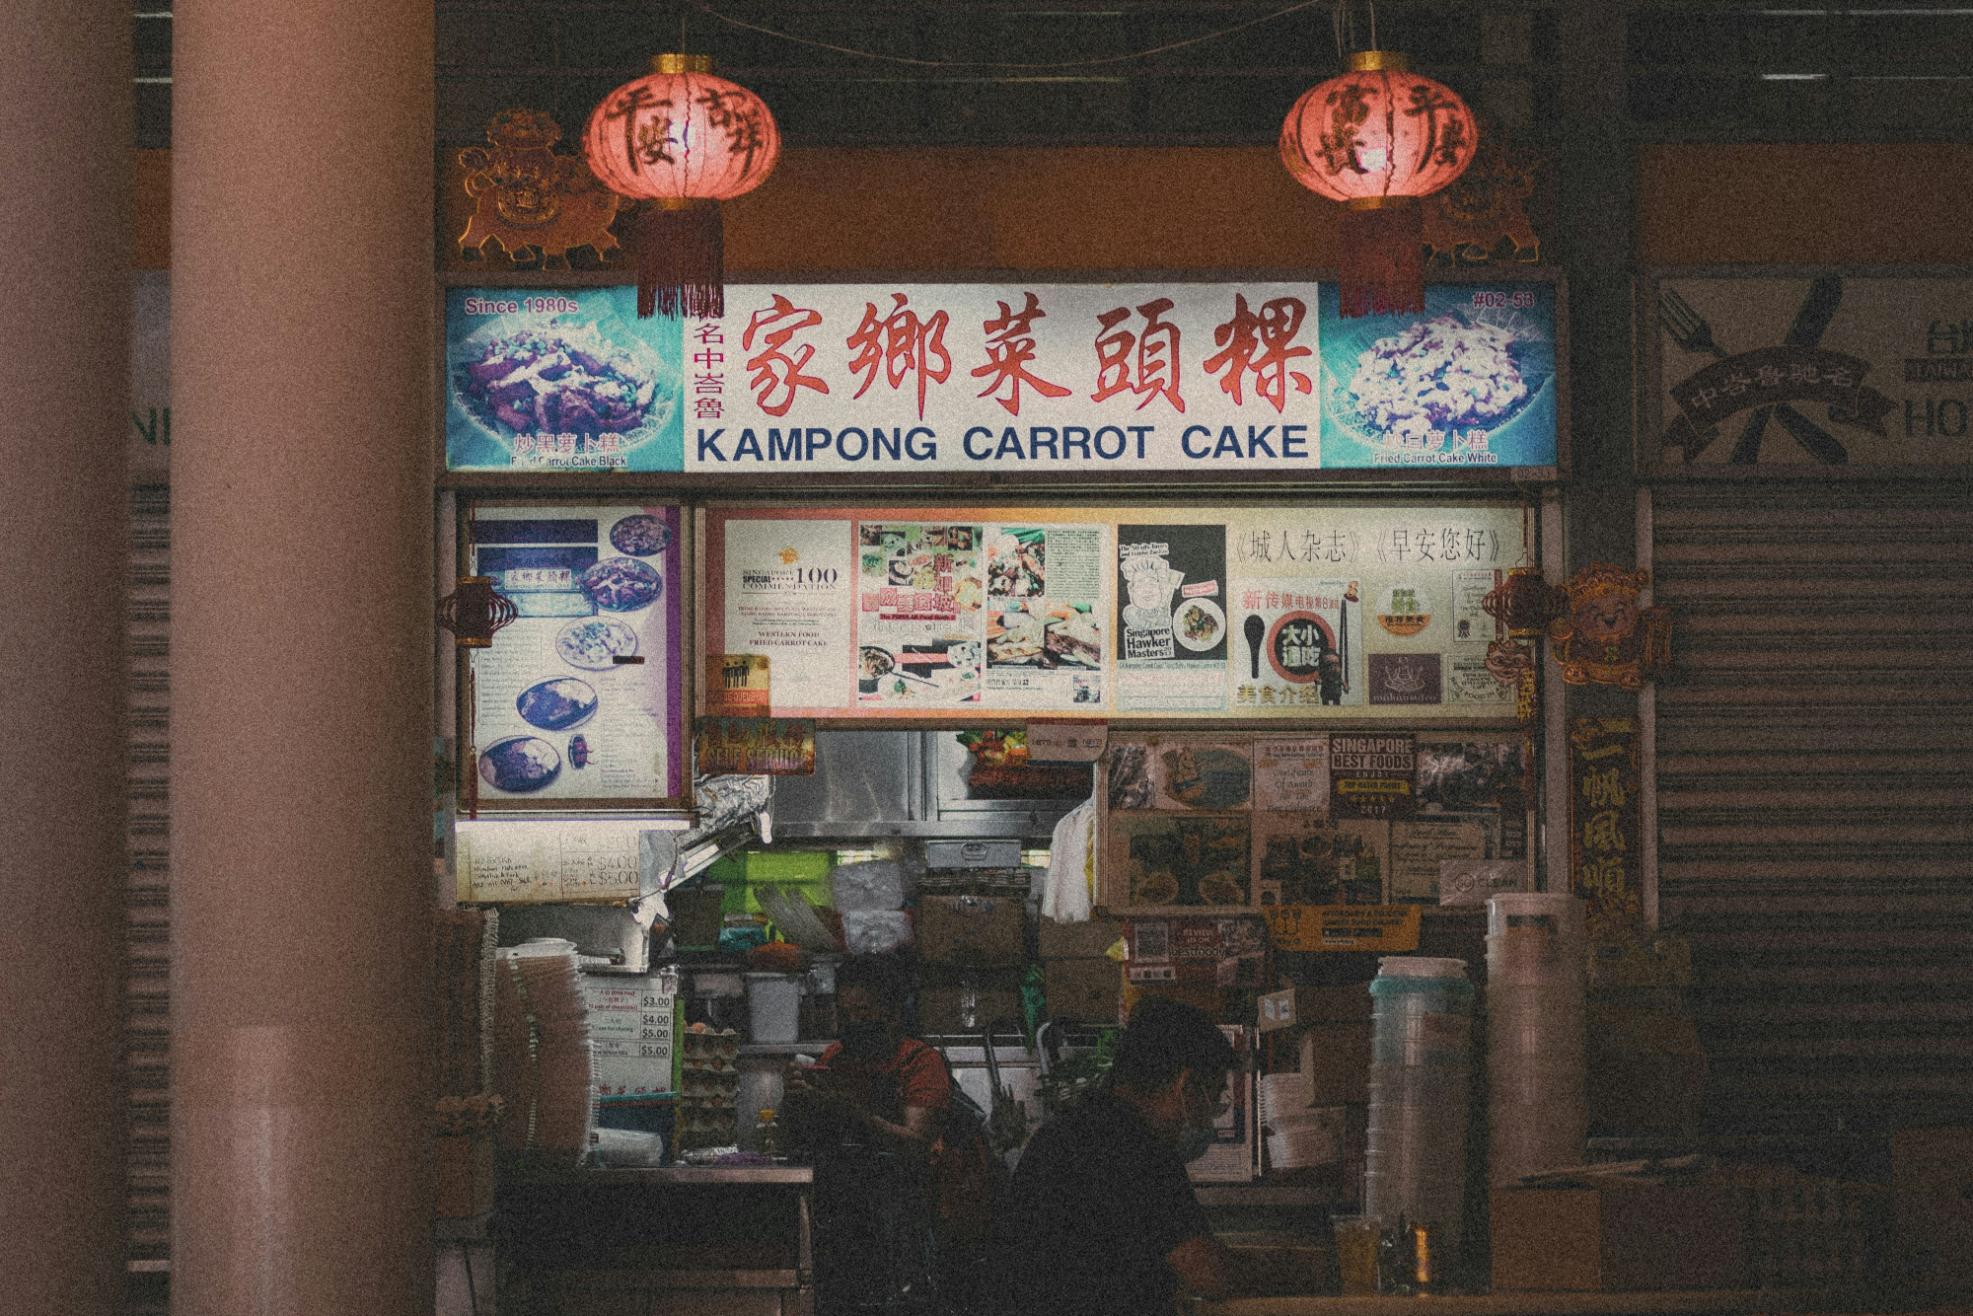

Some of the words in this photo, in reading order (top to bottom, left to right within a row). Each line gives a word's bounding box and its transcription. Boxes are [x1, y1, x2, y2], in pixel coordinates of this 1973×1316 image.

[466, 297, 518, 314] Since
[524, 297, 579, 313] 1980s
[698, 427, 938, 461] KAMPONG
[963, 426, 1154, 460] CARROT
[1181, 425, 1309, 458] CAKE
[571, 456, 598, 467] Cake
[600, 456, 627, 467] Black
[1374, 453, 1401, 464] Fried
[1403, 453, 1437, 464] Carrot
[1439, 453, 1465, 464] Cake
[1466, 453, 1498, 464] White
[797, 567, 838, 584] 100
[1126, 628, 1170, 639] Singapore
[1127, 637, 1171, 649] Hawker
[1128, 649, 1164, 658] Masters
[1332, 738, 1414, 753] SINGAPORE
[1333, 755, 1366, 769] BEST
[1369, 755, 1412, 769] FOODS
[643, 995, 670, 1007] $3.00
[643, 1014, 669, 1025] $4.00
[642, 1028, 668, 1039] $5.00
[641, 1044, 668, 1056] $5.00
